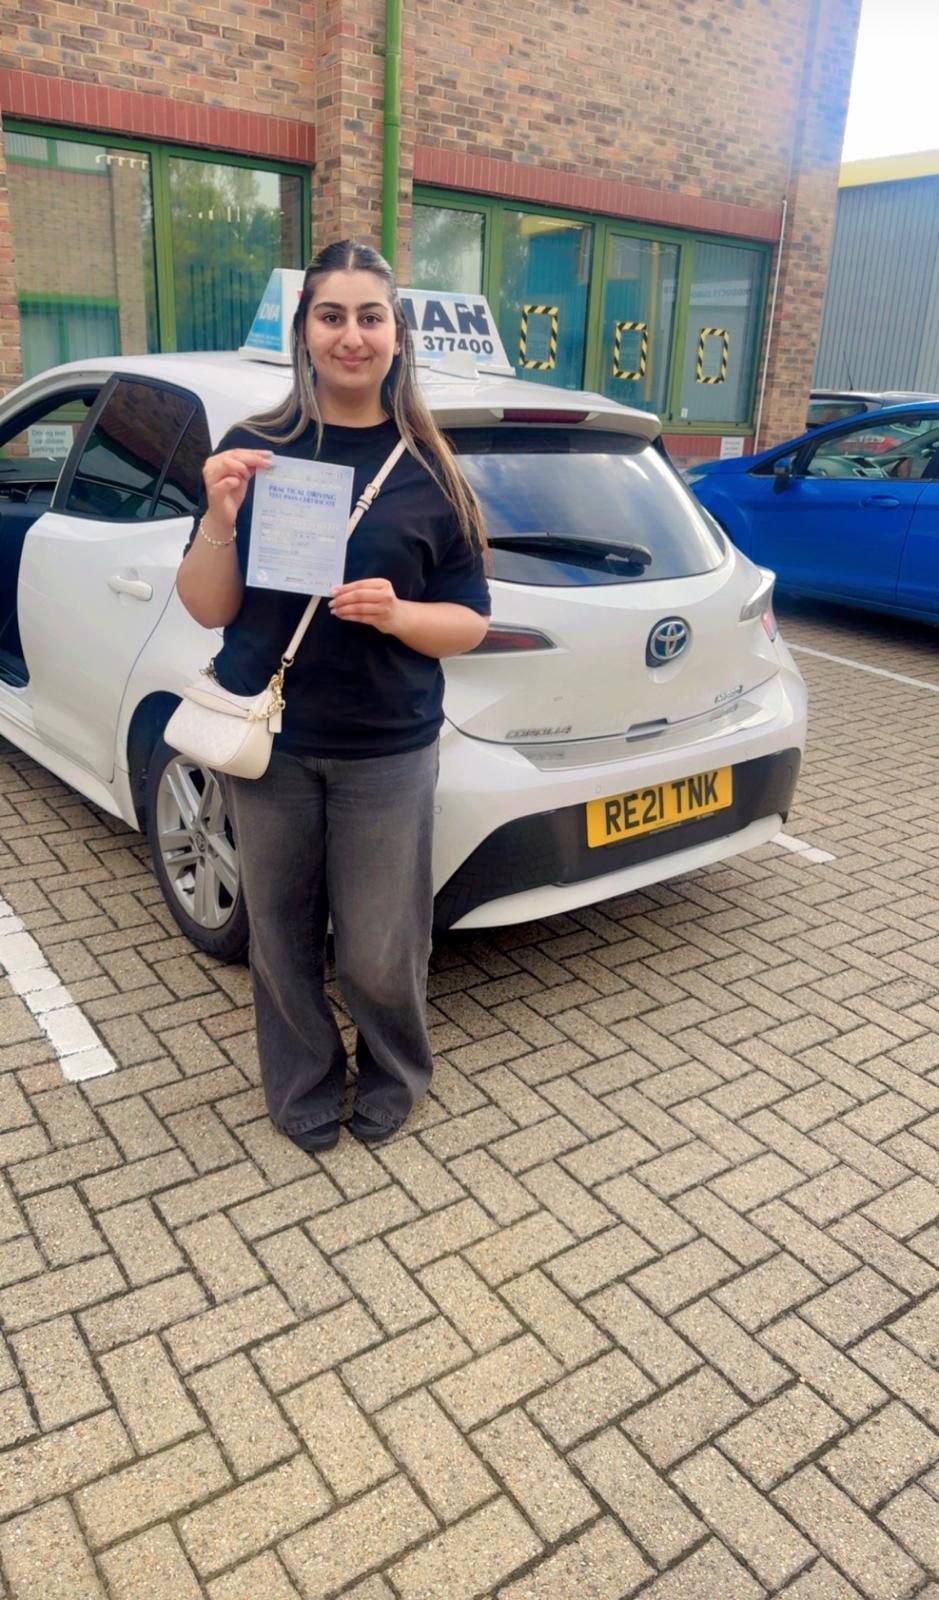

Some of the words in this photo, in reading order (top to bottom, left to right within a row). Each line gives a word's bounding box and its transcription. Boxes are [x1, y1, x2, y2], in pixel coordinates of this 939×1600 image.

[422, 335, 494, 355] 377400
[605, 787, 665, 836] RE21
[672, 771, 719, 814] TNK
